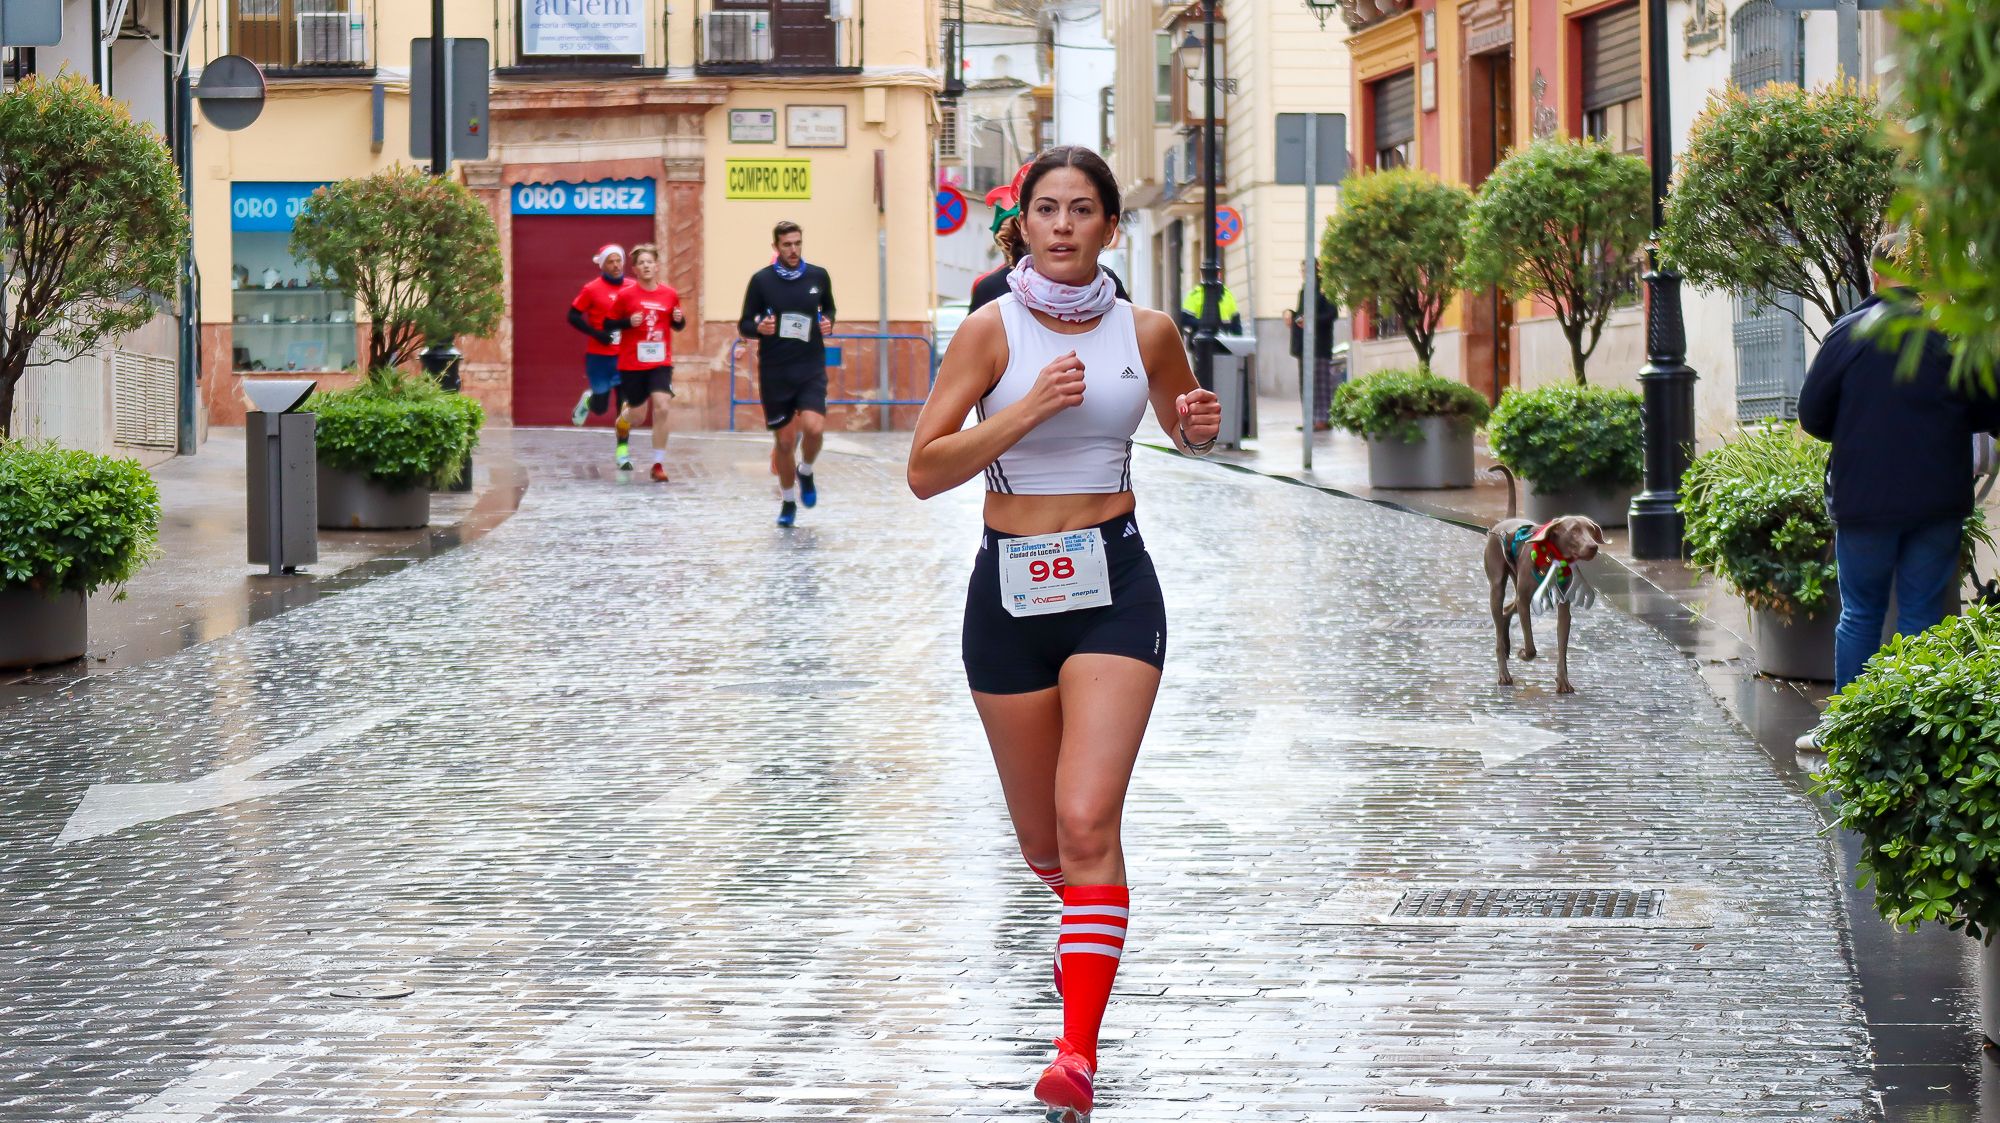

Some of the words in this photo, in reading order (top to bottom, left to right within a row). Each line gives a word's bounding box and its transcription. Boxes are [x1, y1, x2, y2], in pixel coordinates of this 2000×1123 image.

[591, 21, 600, 29] de
[729, 166, 779, 192] COMPRO
[783, 166, 807, 192] ORO
[233, 197, 277, 218] ORO
[518, 187, 566, 209] ORO
[573, 187, 645, 209] JEREZ
[1009, 550, 1029, 559] Ciudad
[1037, 548, 1061, 556] Lucena
[1029, 557, 1075, 583] 98
[1071, 589, 1098, 597] enerplus
